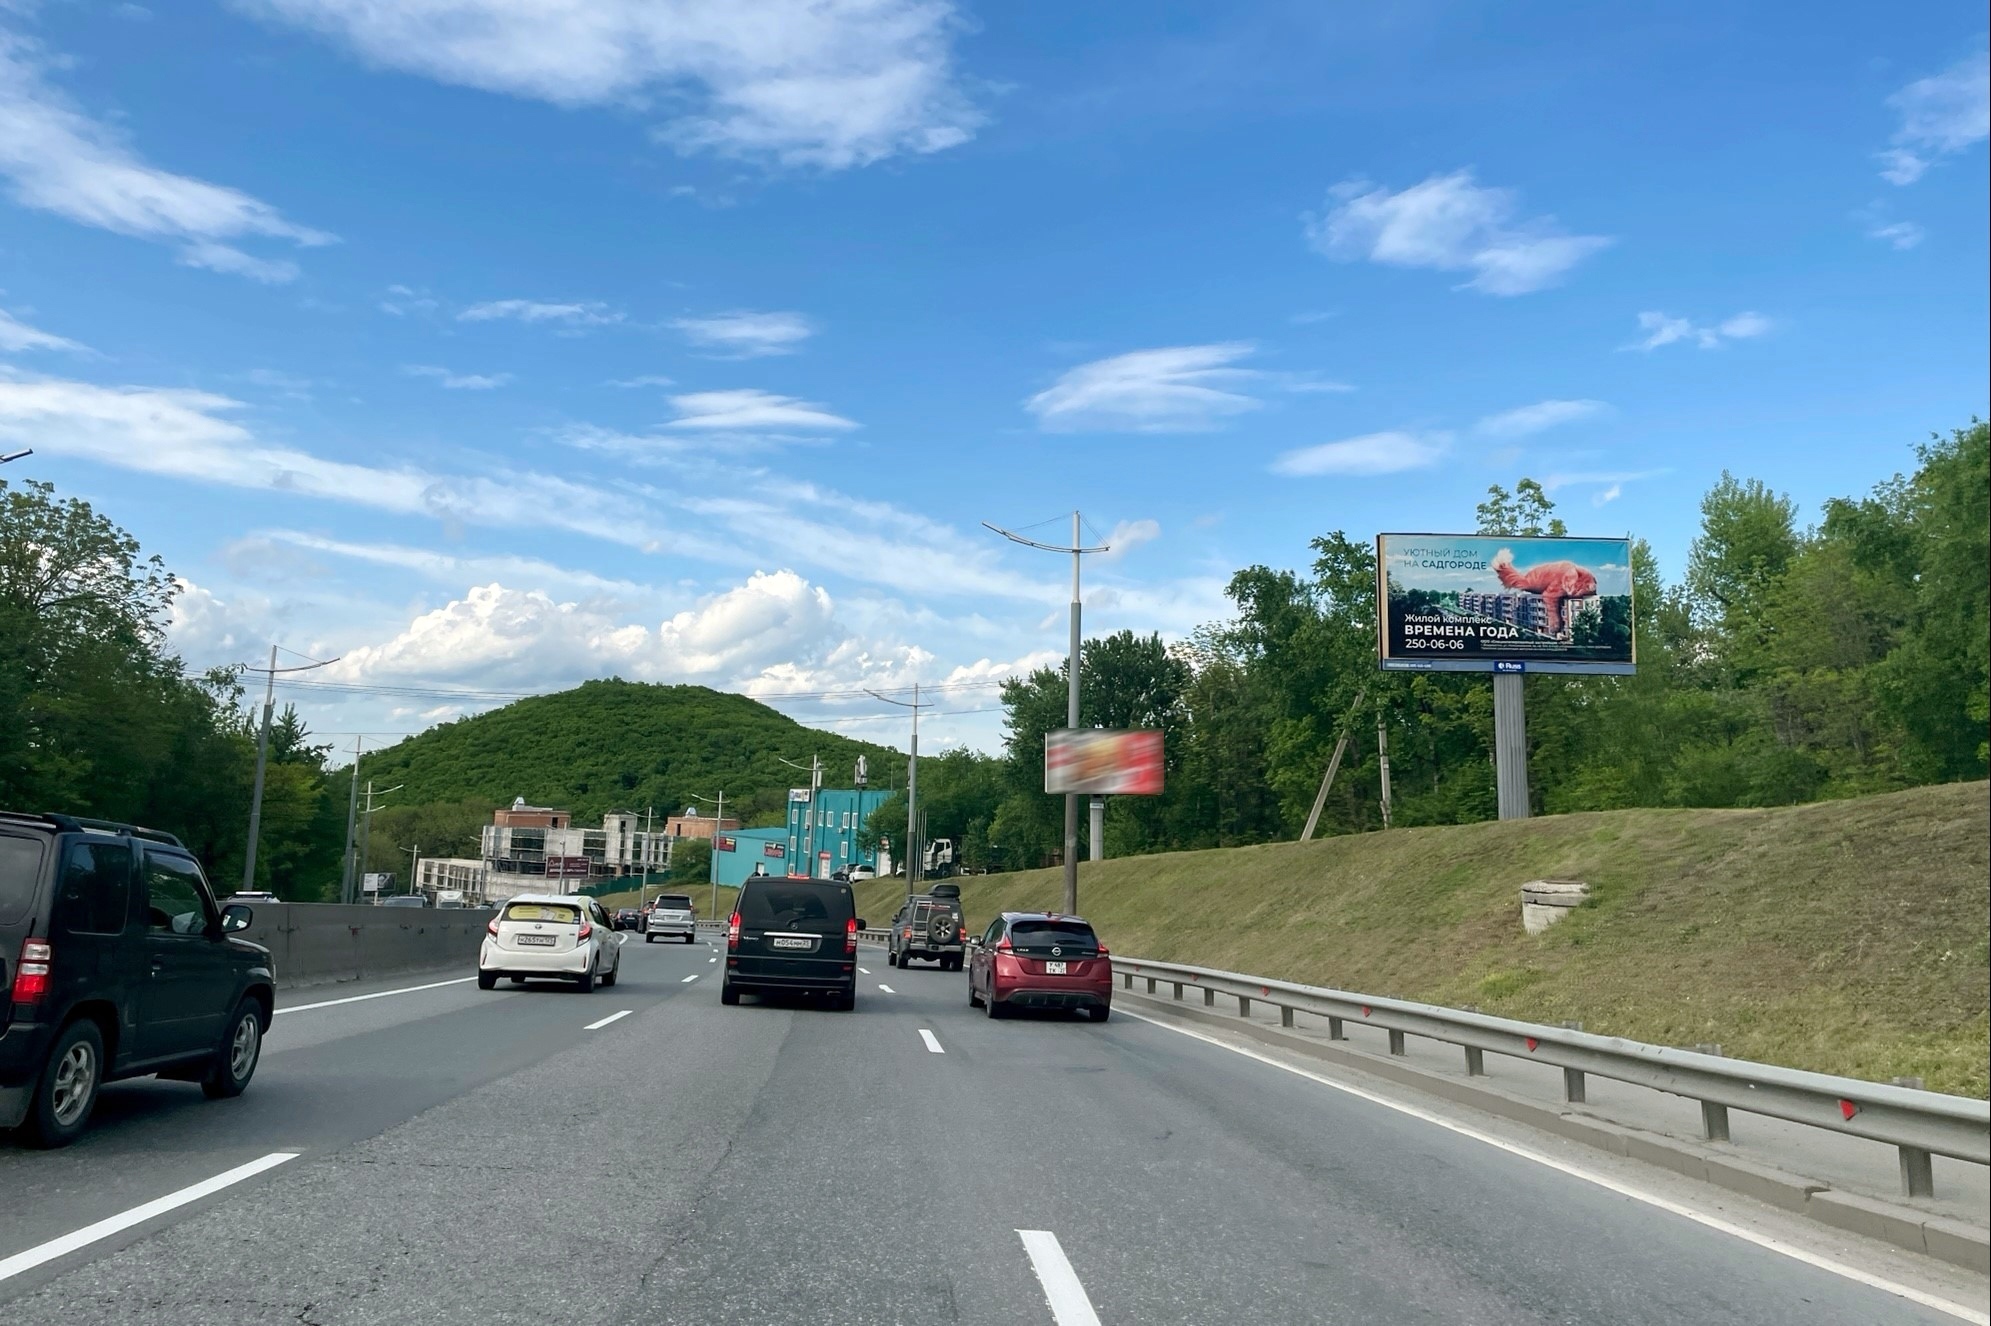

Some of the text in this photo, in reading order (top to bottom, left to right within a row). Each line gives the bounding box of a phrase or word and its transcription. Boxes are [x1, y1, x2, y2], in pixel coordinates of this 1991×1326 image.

[1403, 547, 1478, 559] УЮТНЫЙ ДОМ
[1403, 560, 1487, 570] НА САДГОРОДЕ
[1404, 613, 1492, 624] Жилой комплекс
[1404, 624, 1519, 639] ВРЕМЕНА ГОДА
[1405, 638, 1465, 650] 250-06-06
